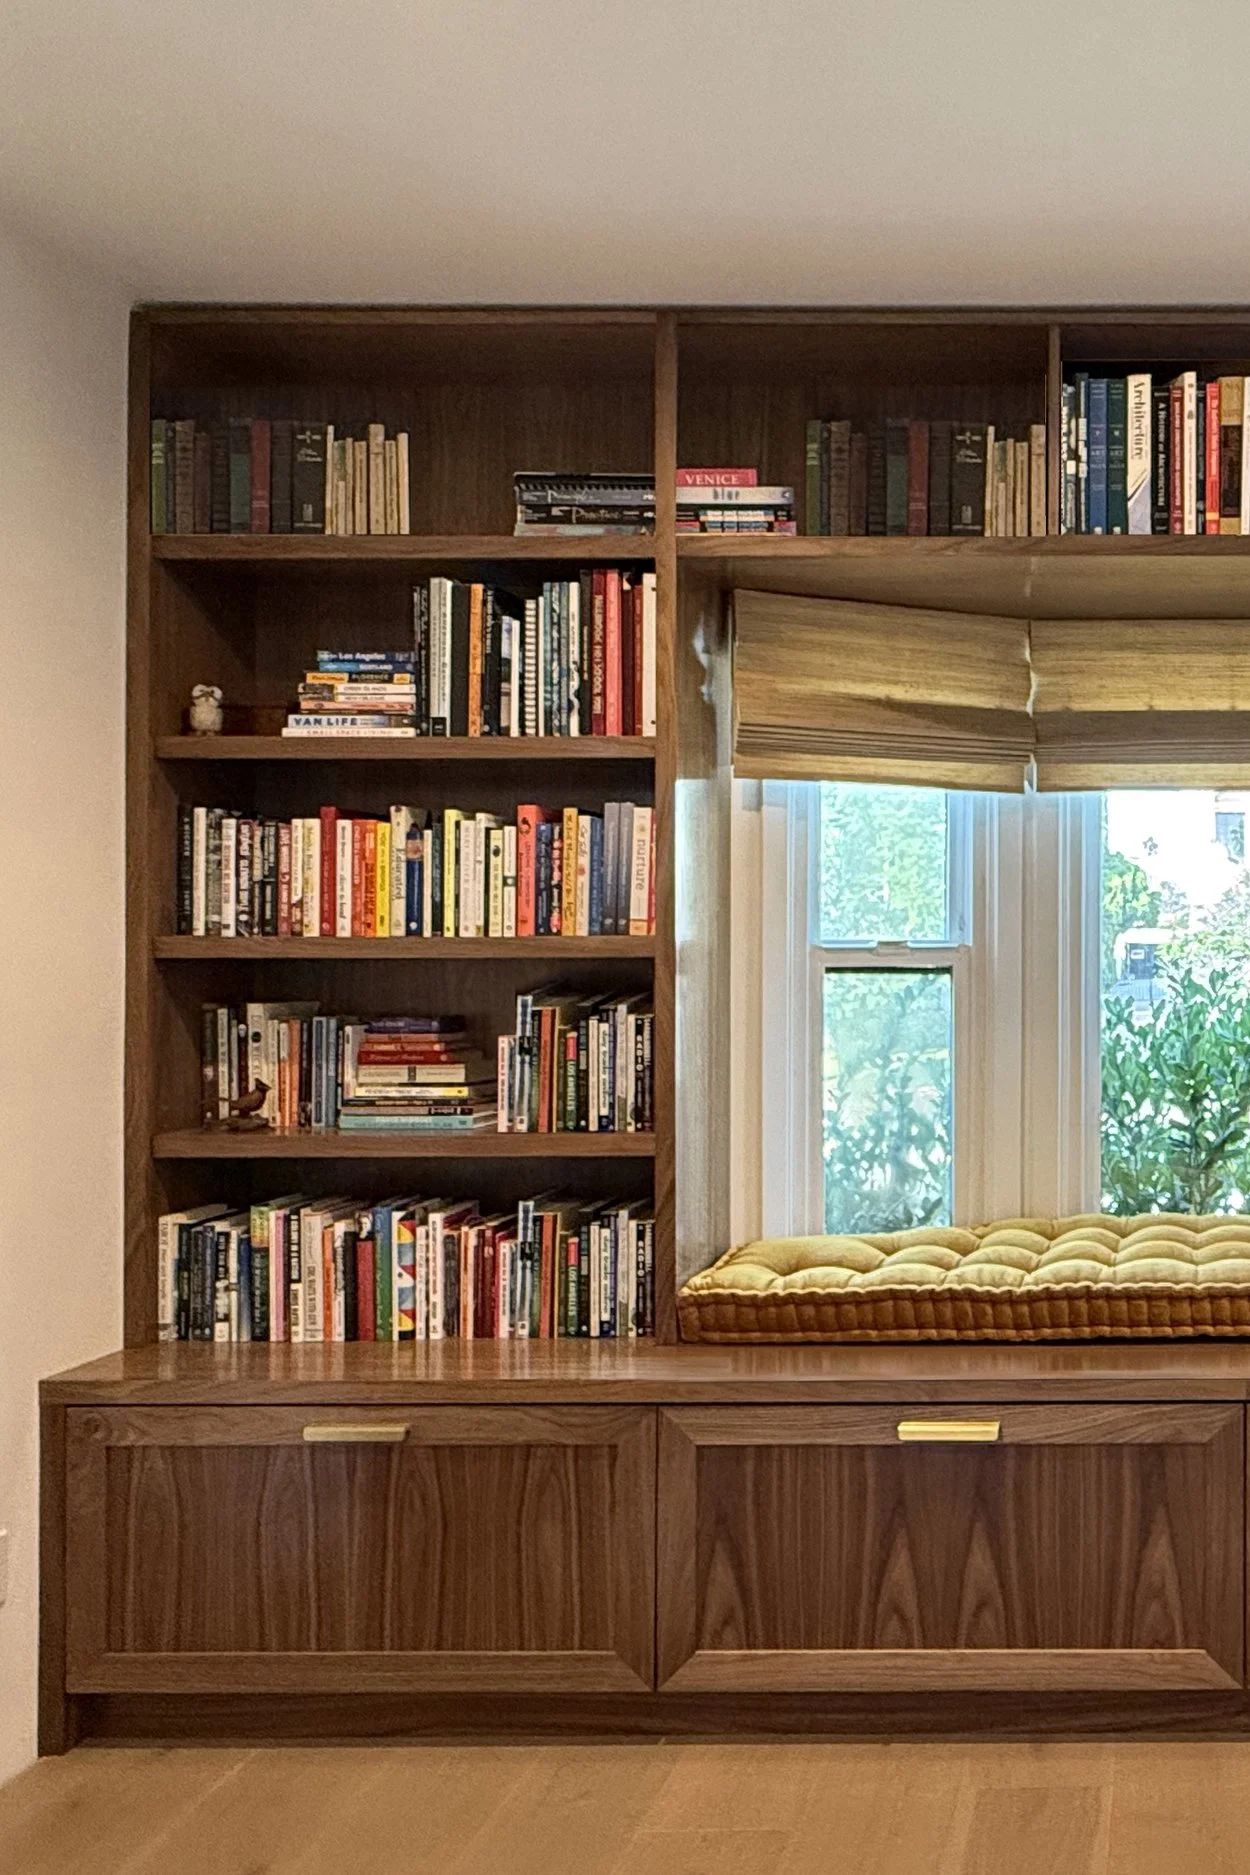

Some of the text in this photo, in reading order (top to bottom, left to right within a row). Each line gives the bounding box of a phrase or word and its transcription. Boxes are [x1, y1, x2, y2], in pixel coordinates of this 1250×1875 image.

[1133, 381, 1147, 460] Architecture
[684, 474, 740, 485] VENICE
[339, 651, 353, 660] Los
[293, 718, 358, 726] VAN LIFE
[395, 848, 405, 899] Educated
[636, 839, 646, 891] nurture
[566, 1061, 576, 1111] LOS ANGELES
[568, 1266, 578, 1316] LOS ANGELES
